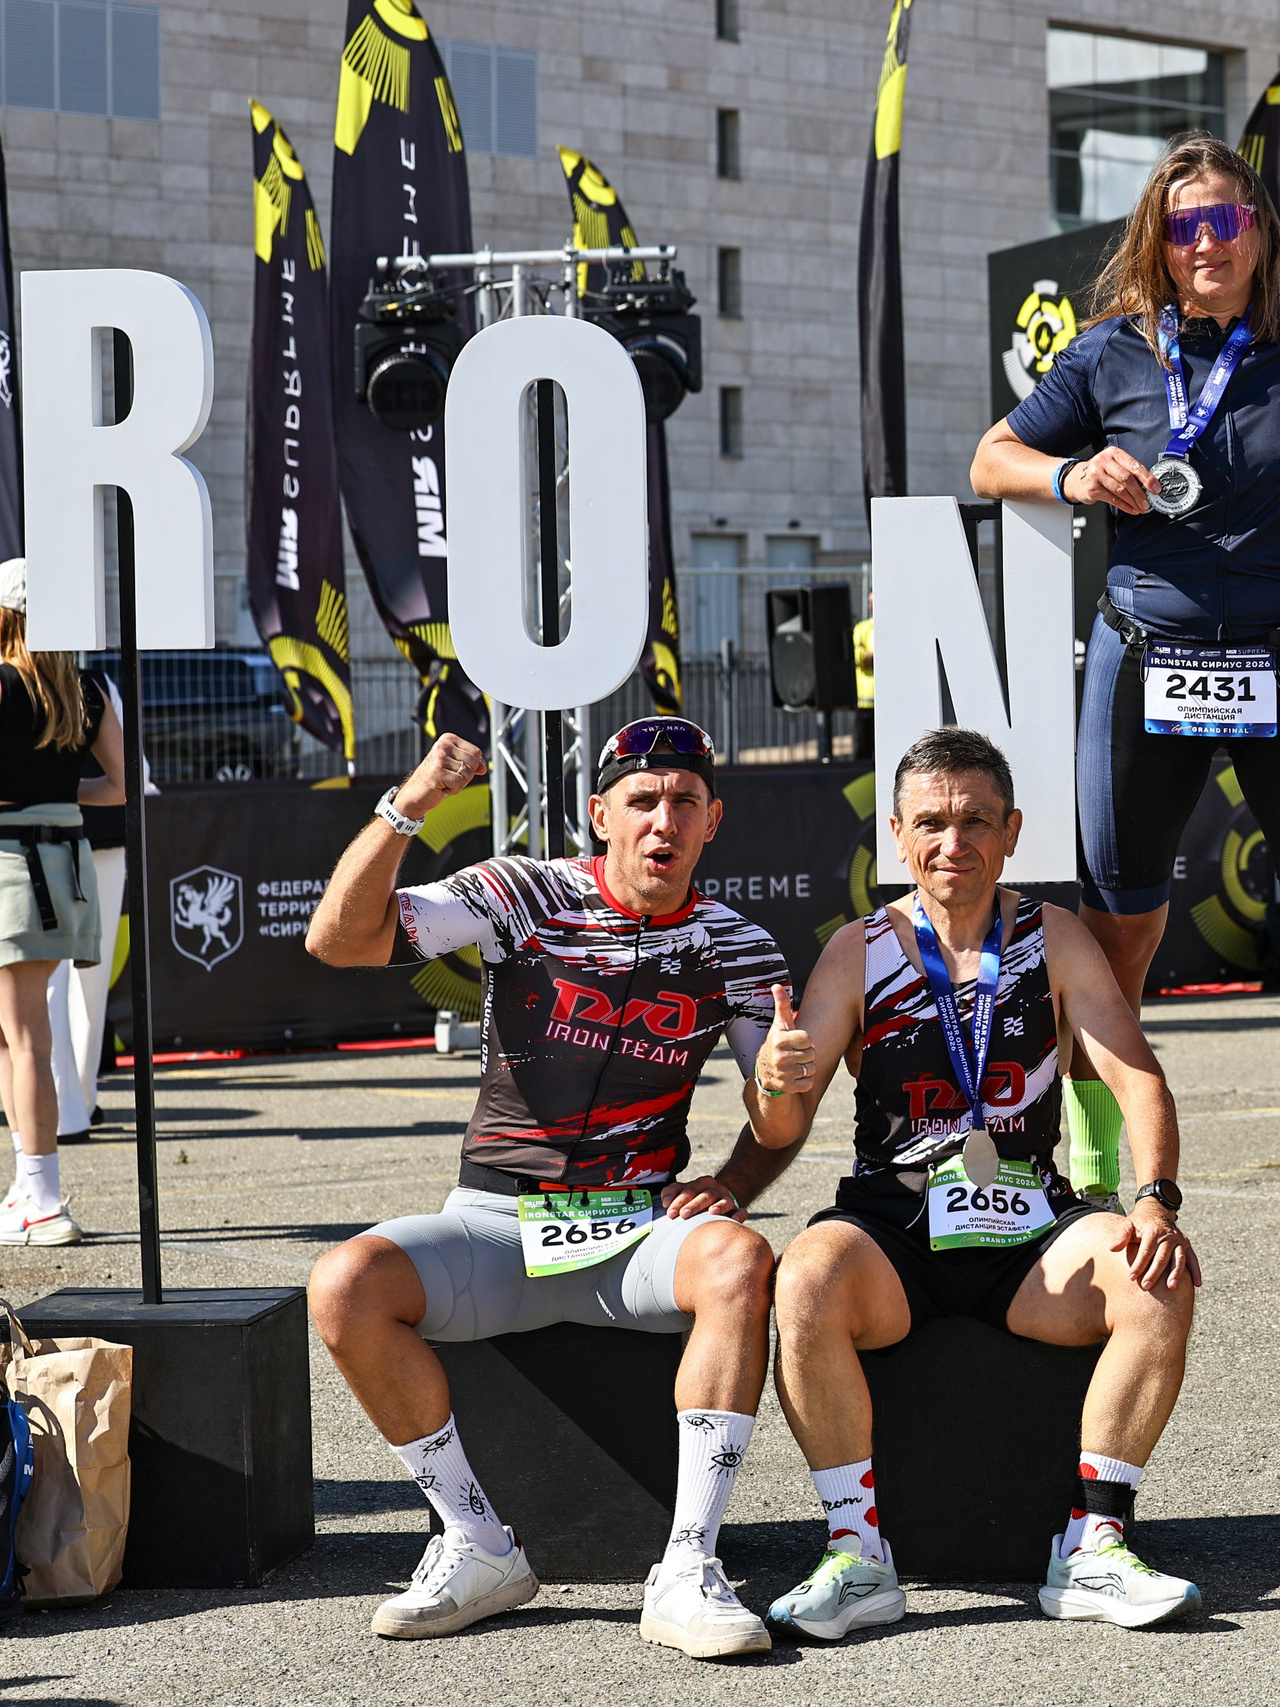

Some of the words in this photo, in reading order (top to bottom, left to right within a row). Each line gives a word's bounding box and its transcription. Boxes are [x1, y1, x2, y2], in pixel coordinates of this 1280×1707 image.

[1150, 657, 1199, 668] IRONSTAR
[1201, 661, 1243, 669] СИРИУС
[1165, 673, 1256, 702] 2431
[1177, 705, 1243, 714] ОЛИМПИЙСКАЯ
[1183, 713, 1236, 721] ДИСТАНЦИЯ
[1192, 726, 1221, 734] GRAND
[694, 873, 811, 900] PREME
[257, 900, 321, 917] ТЕРРИТ
[259, 921, 309, 938] «СИРИ
[481, 970, 494, 1040] IronTeam
[975, 993, 985, 1027] СИРИУС
[944, 994, 960, 1036] IRONSTAR
[981, 994, 992, 1036] IRONSTAR
[937, 996, 952, 1029] СИРИУС
[947, 1031, 957, 1052] 2026
[545, 1020, 611, 1051] IRON
[619, 1037, 690, 1067] TEAM
[911, 1117, 961, 1134] IRON
[934, 1171, 968, 1184] IRONS
[1015, 1177, 1036, 1187] 2026
[946, 1187, 1031, 1216] 2656
[524, 1210, 576, 1219] IRONSTAR
[579, 1208, 619, 1217] СИРИУС
[622, 1204, 647, 1213] 2026
[954, 1223, 997, 1232] ДИСТАНЦИЯ
[968, 1217, 1016, 1226] ОЛИМПИЙСКАЯ
[541, 1218, 637, 1247] 2656
[980, 1236, 1006, 1244] GRAND
